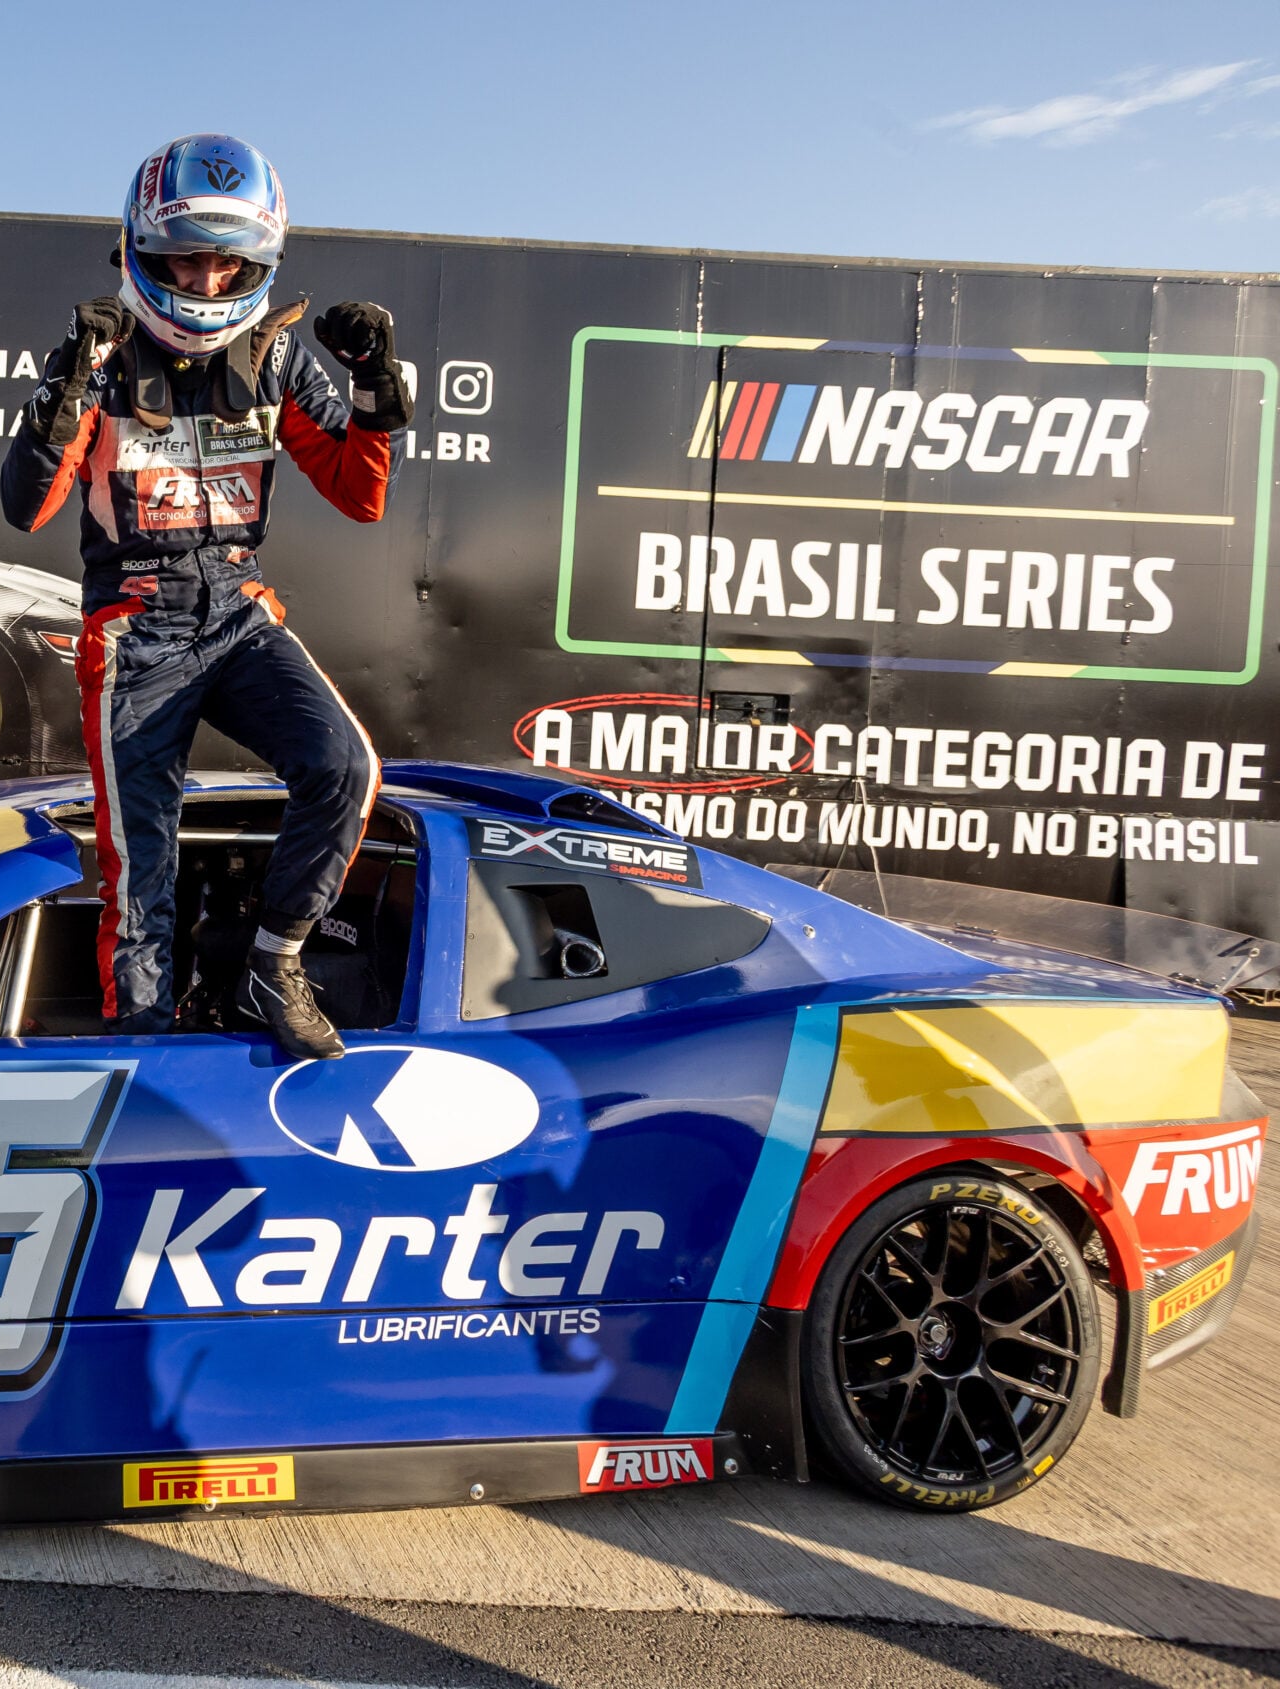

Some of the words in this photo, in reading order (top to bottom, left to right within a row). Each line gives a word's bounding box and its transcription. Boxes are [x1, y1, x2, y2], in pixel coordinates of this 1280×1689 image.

[155, 201, 191, 221] FRUM
[210, 440, 236, 450] BRASIL
[798, 384, 1150, 479] NASCAR
[147, 472, 255, 509] FRUM
[634, 531, 896, 623] BRASIL
[917, 546, 1176, 634] SERIES
[533, 709, 573, 768] A
[589, 711, 797, 774] MAIOR
[812, 722, 1166, 797] CATEGORIA
[1181, 740, 1267, 801] DE
[477, 818, 688, 872] EXTREME
[747, 797, 807, 843] DO
[819, 803, 1000, 859] MUNDO,
[1013, 811, 1077, 856] NO
[1087, 815, 1259, 865] BRASIL
[609, 863, 688, 884] SIMRACING
[320, 917, 358, 946] sparco
[930, 1183, 951, 1200] P
[954, 1183, 1043, 1225] ZERO
[115, 1184, 665, 1310] Karter
[1157, 1260, 1227, 1326] PIRELLI
[338, 1308, 601, 1345] LUBRIFICANTES
[139, 1462, 278, 1501] PIRELLI
[587, 1441, 705, 1485] FRUM
[879, 1472, 995, 1506] PIRELLI
